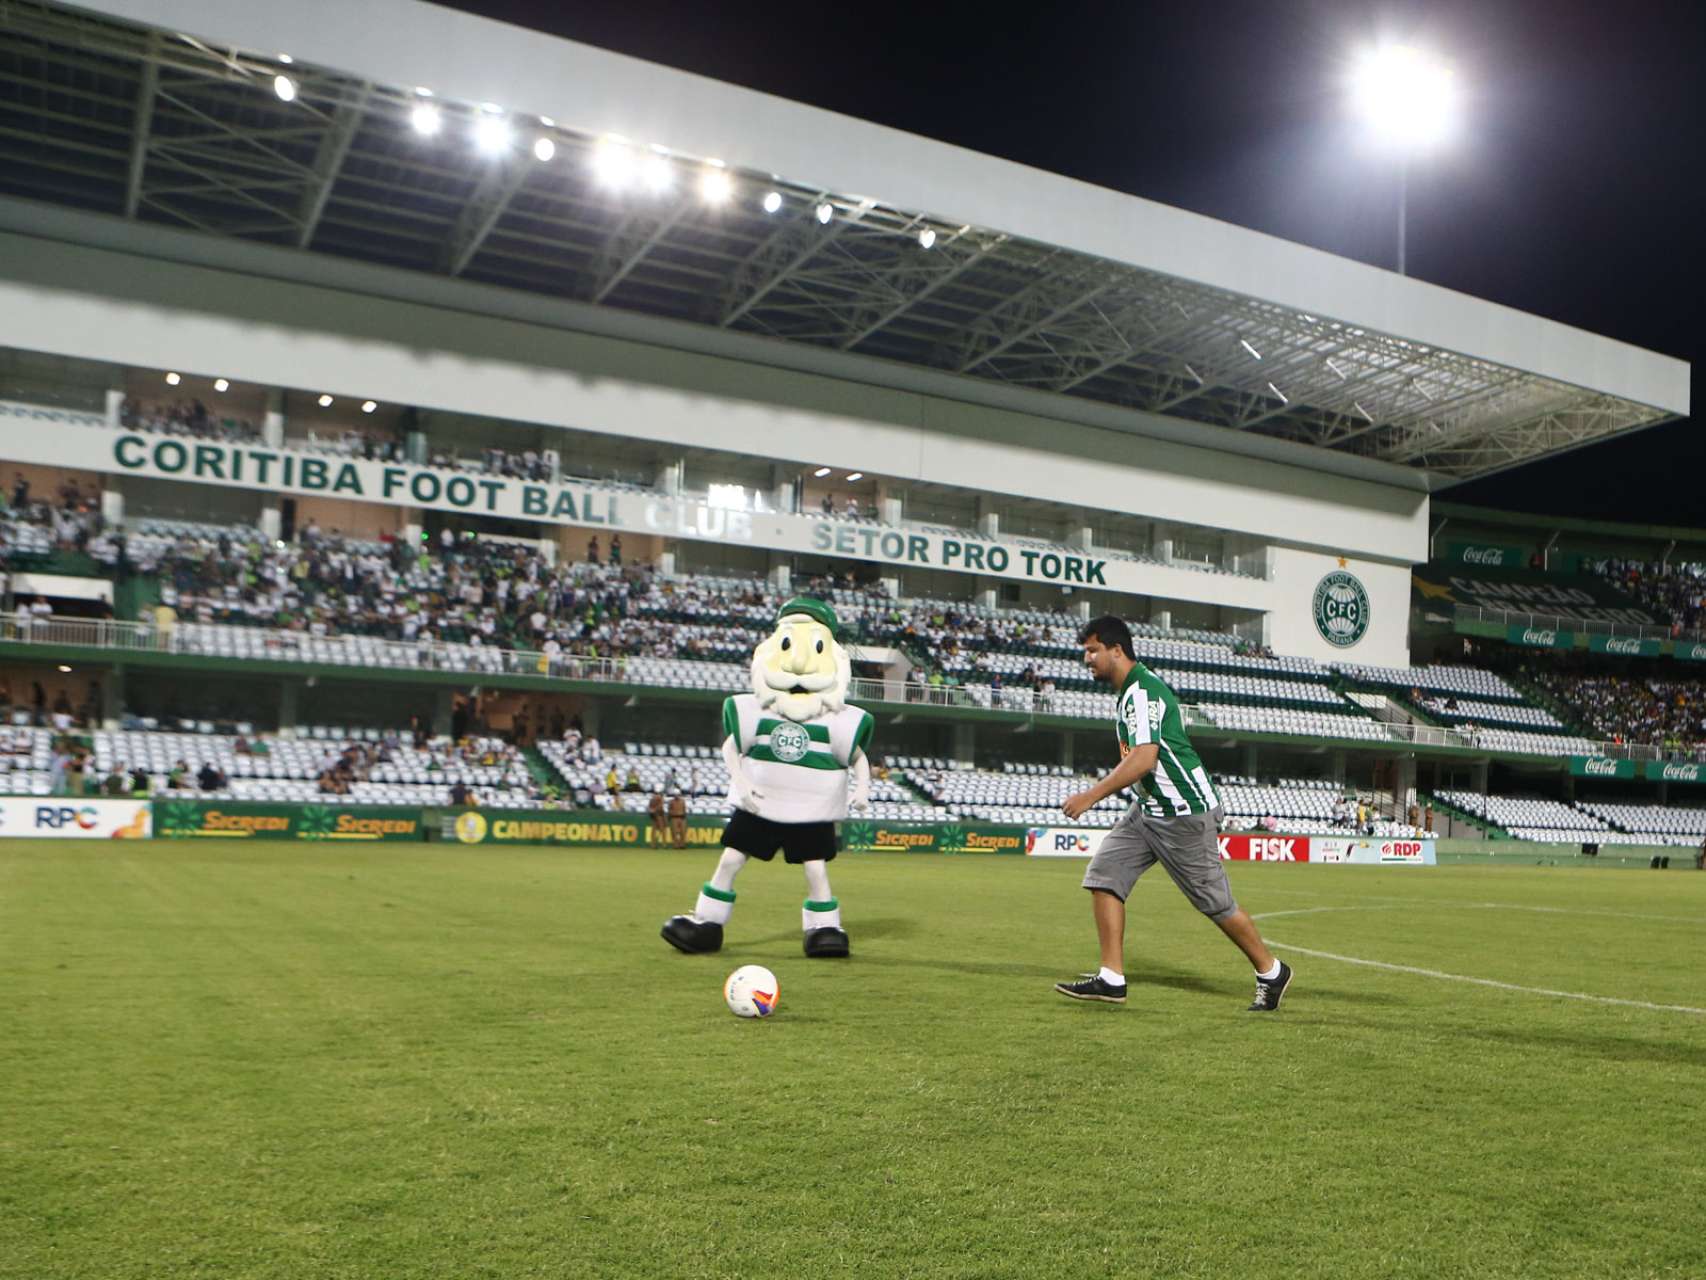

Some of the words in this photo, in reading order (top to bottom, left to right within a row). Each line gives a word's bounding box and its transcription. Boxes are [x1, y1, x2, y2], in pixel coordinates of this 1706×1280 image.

[113, 435, 364, 496] CORITIBA
[382, 467, 506, 510] FOOT
[522, 485, 621, 524] BALL
[645, 500, 753, 543] CLUB
[810, 522, 930, 563] SETOR
[941, 539, 1009, 572] PRO
[1020, 549, 1107, 585] TORK
[1327, 600, 1357, 620] CFC
[35, 806, 98, 830] RPC
[492, 820, 638, 843] CAMPEONATO
[1055, 834, 1089, 851] RPC
[1249, 838, 1296, 861] FISK
[1393, 842, 1421, 857] RDP
